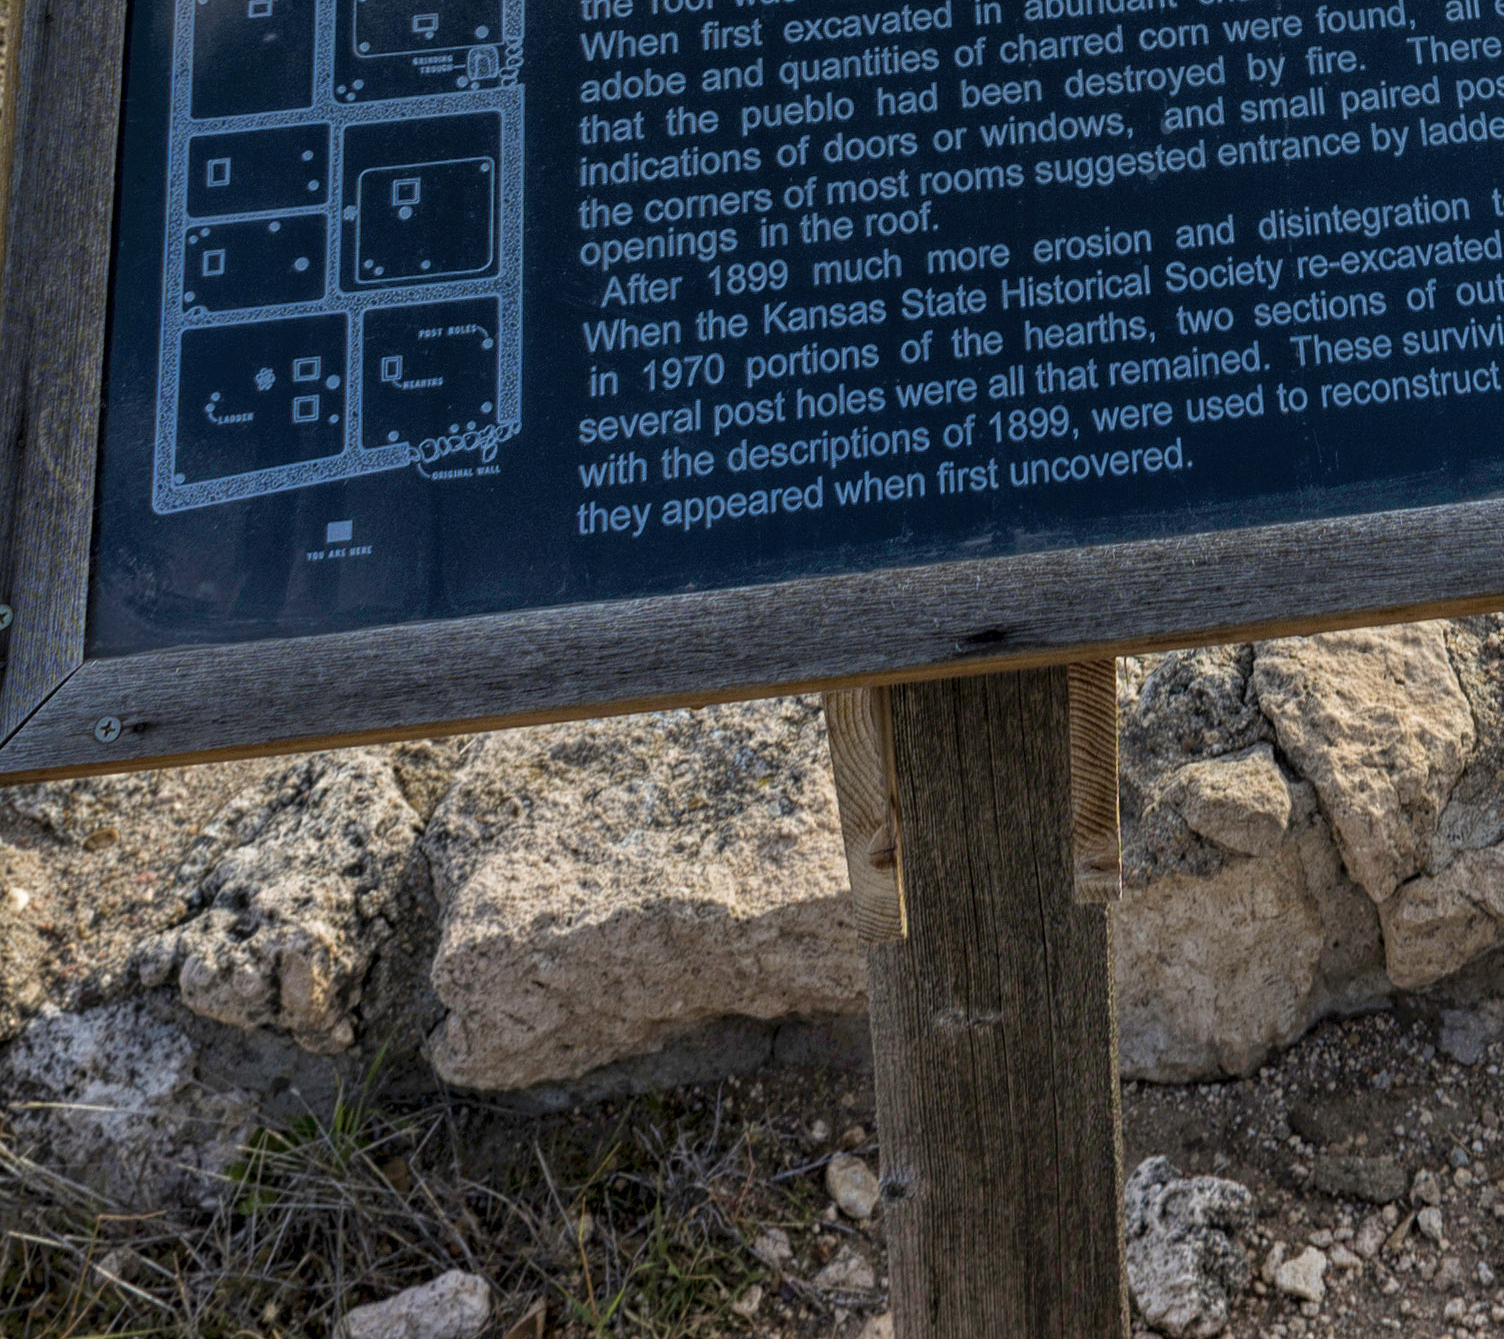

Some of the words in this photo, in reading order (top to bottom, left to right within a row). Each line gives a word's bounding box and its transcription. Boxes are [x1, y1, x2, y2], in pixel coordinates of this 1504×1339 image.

[579, 29, 679, 62] When
[700, 17, 763, 51] first
[783, 0, 953, 44] excavated
[579, 67, 687, 104] adobe
[701, 57, 764, 93] and
[778, 44, 940, 91] quantities
[953, 35, 987, 69] of
[999, 24, 1124, 64] charred
[1138, 23, 1210, 52] corn
[1222, 14, 1303, 43] were
[578, 110, 645, 146] that
[665, 105, 719, 137] the
[741, 91, 855, 138] pueblo
[876, 81, 939, 117] had
[960, 78, 1043, 109] been
[1064, 54, 1226, 99] destroyed
[1246, 52, 1286, 87] by
[1304, 45, 1366, 76] fire.
[1405, 34, 1502, 65] There
[579, 145, 762, 188] indications
[775, 134, 811, 168] of
[823, 131, 919, 164] doors
[932, 126, 968, 153] or
[979, 111, 1134, 148] windows,
[1162, 95, 1225, 134] and
[1239, 86, 1326, 123] small
[1340, 75, 1441, 121] paired
[577, 197, 634, 231] the
[644, 188, 774, 224] corners
[783, 175, 818, 210] of
[826, 168, 910, 206] most
[919, 163, 1025, 196] rooms
[1034, 138, 1207, 189] suggested
[1217, 130, 1361, 167] entrance
[1370, 122, 1410, 158] by
[579, 226, 739, 272] openings
[760, 217, 789, 248] in
[799, 212, 854, 244] the
[865, 199, 939, 238] roof.
[600, 272, 683, 309] After
[707, 258, 789, 297] 1899
[813, 247, 903, 287] much
[926, 243, 1011, 275] more
[1032, 225, 1153, 264] erosion
[1175, 213, 1235, 250] and
[1257, 193, 1471, 241] disintegration
[418, 327, 443, 339] POST
[447, 324, 477, 336] HOLES
[582, 318, 682, 354] When
[695, 308, 749, 343] the
[763, 298, 887, 335] Kansas
[901, 283, 988, 321] State
[1001, 264, 1151, 310] Historical
[1165, 253, 1284, 293] Society
[1296, 228, 1503, 280] re-excavated
[589, 365, 619, 398] in
[642, 352, 725, 392] 1970
[746, 342, 880, 389] portions
[900, 329, 934, 365] of
[950, 326, 1004, 359] the
[1024, 311, 1156, 352] hearths,
[1175, 305, 1234, 336] two
[1253, 289, 1387, 328] sections
[1406, 277, 1437, 312] of
[218, 412, 254, 424] LADDER
[578, 398, 702, 445] several
[713, 390, 786, 437] post
[796, 383, 887, 420] holes
[895, 377, 978, 409] were
[988, 364, 1025, 400] all
[1034, 358, 1100, 395] that
[1108, 339, 1271, 387] remained.
[1289, 333, 1393, 367] These
[578, 451, 648, 489] with
[660, 445, 715, 480] the
[726, 425, 931, 473] descriptions
[942, 413, 977, 449] of
[988, 404, 1079, 444] 1899,
[1090, 401, 1173, 433] were
[1186, 383, 1265, 424] used
[1275, 382, 1309, 414] to
[1320, 360, 1502, 409] reconstruct
[431, 467, 473, 481] ORIGINAL
[478, 464, 501, 475] WALL
[576, 500, 652, 538] they
[661, 475, 824, 532] appeared
[833, 470, 926, 506] when
[936, 457, 1000, 495] first
[1009, 436, 1193, 488] uncovered.
[306, 550, 325, 562] YOU
[328, 547, 346, 559] ARE
[350, 545, 373, 557] HERE
